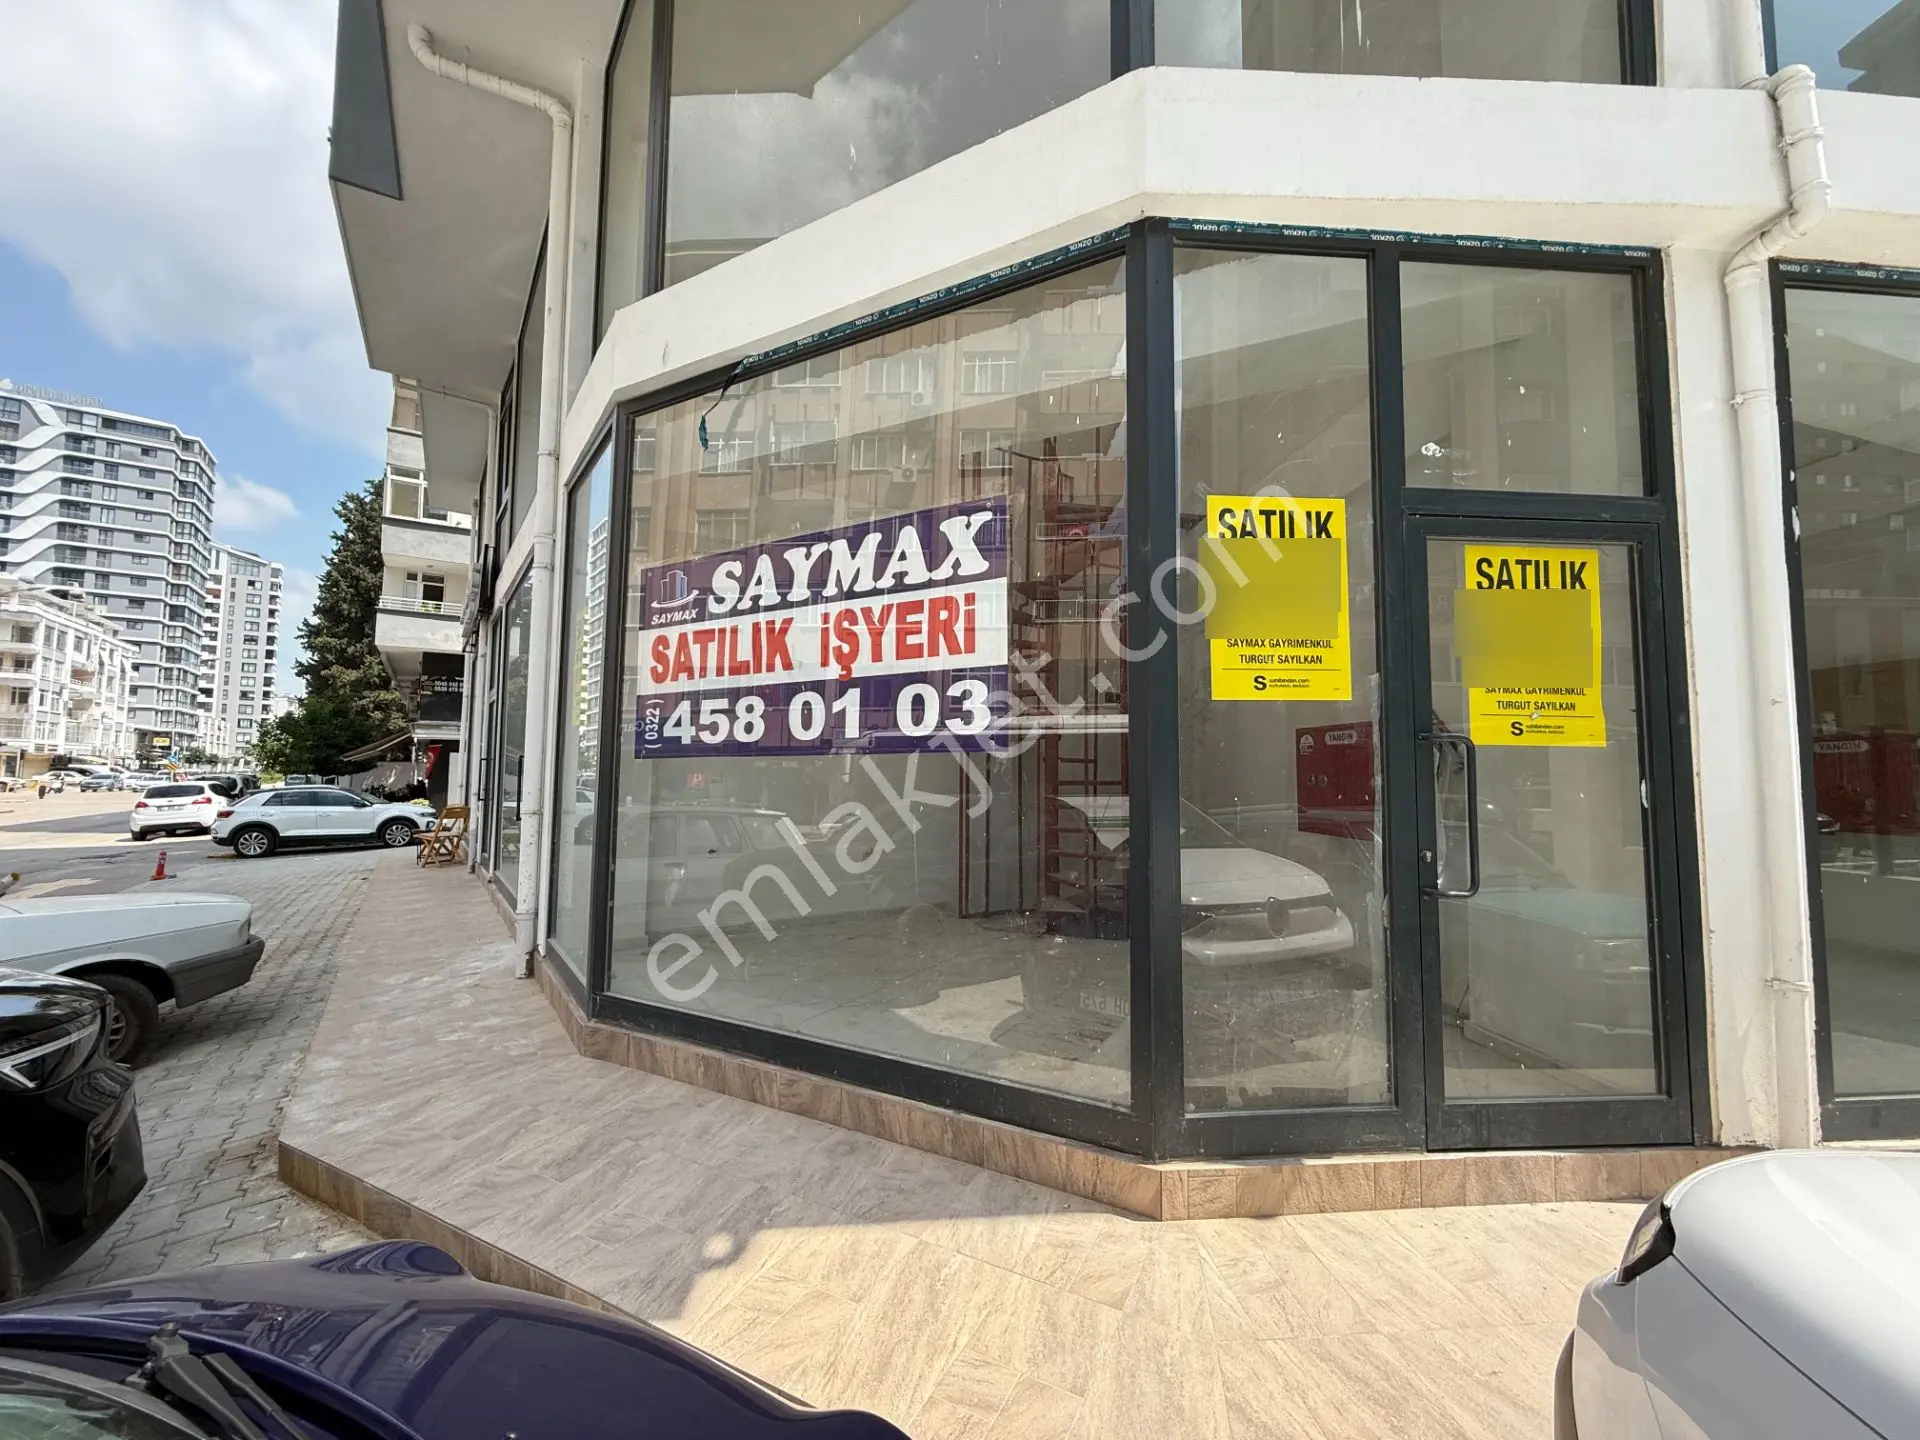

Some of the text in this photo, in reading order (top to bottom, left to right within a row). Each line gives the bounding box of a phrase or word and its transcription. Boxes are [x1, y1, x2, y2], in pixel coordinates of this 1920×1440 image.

[707, 511, 993, 614] SAYMAX
[650, 608, 699, 626] SAYMAX
[649, 616, 795, 684] SATILIK
[1226, 638, 1266, 648] SAYMAX
[1239, 654, 1323, 665] TURGUT SAYILKAN
[662, 695, 766, 745] 458
[788, 687, 861, 741] 01
[896, 679, 992, 737] 03
[1496, 700, 1576, 712] TURGUT SAYILKAN
[1818, 741, 1861, 751] YANGIN
